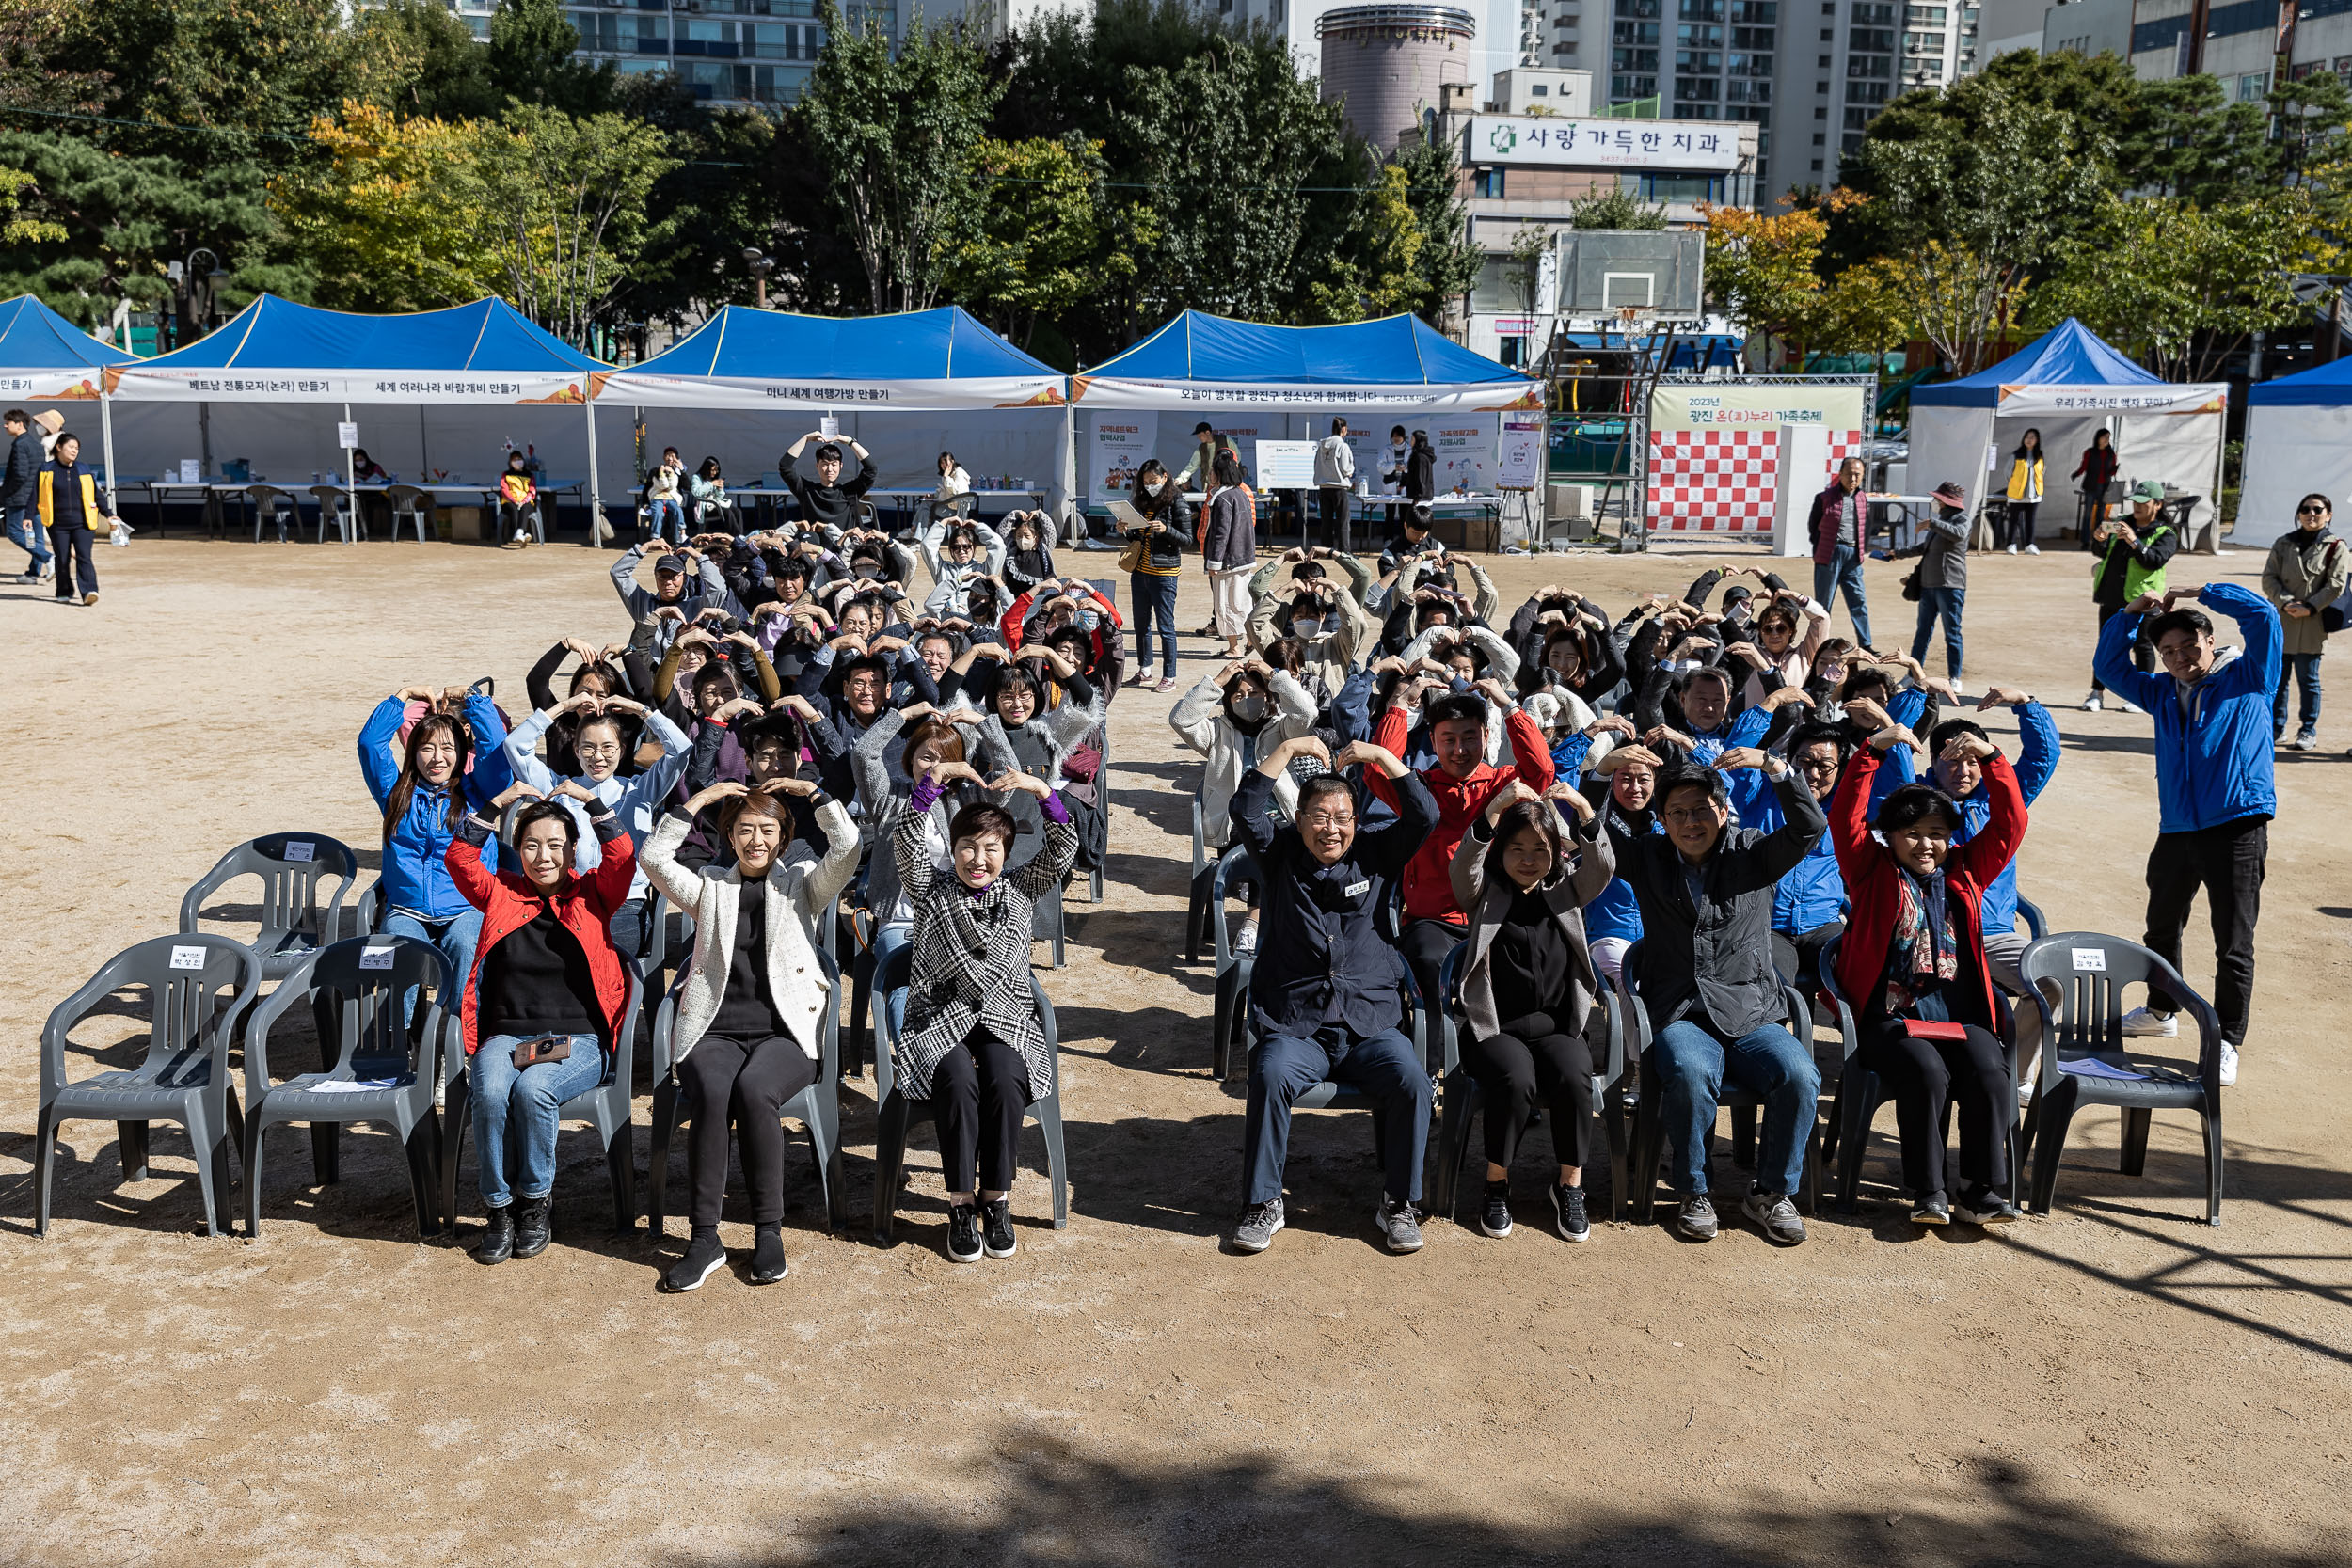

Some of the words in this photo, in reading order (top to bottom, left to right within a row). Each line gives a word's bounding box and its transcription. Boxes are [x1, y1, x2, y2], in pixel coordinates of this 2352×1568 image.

[1526, 127, 1578, 150] 사랑
[1587, 129, 1662, 154] 가득한
[1672, 133, 1721, 153] 치과
[0, 379, 32, 390] 만들기
[189, 380, 220, 391] 베트남
[224, 380, 294, 392] 전통모자(논라)
[298, 381, 330, 392] 만들기
[376, 382, 396, 393] 세계
[400, 382, 440, 393] 여러나라
[444, 383, 486, 394] 바람개비
[489, 383, 520, 394] 만들기
[766, 388, 787, 399] 미니
[790, 388, 811, 399] 세계
[814, 388, 855, 400] 여행가방
[858, 388, 889, 400] 만들기
[1181, 389, 1211, 400] 오늘이
[1215, 389, 1245, 401] 행복할
[1248, 390, 1279, 402] 광진구
[1282, 390, 1323, 403] 청소년과
[1327, 391, 1377, 403] 함께합니다
[1689, 397, 1720, 406] 2023년
[2054, 397, 2074, 408] 우리
[2076, 397, 2117, 408] 가족사진
[1690, 410, 1712, 422] 광진
[1775, 410, 1822, 422] 가족축제
